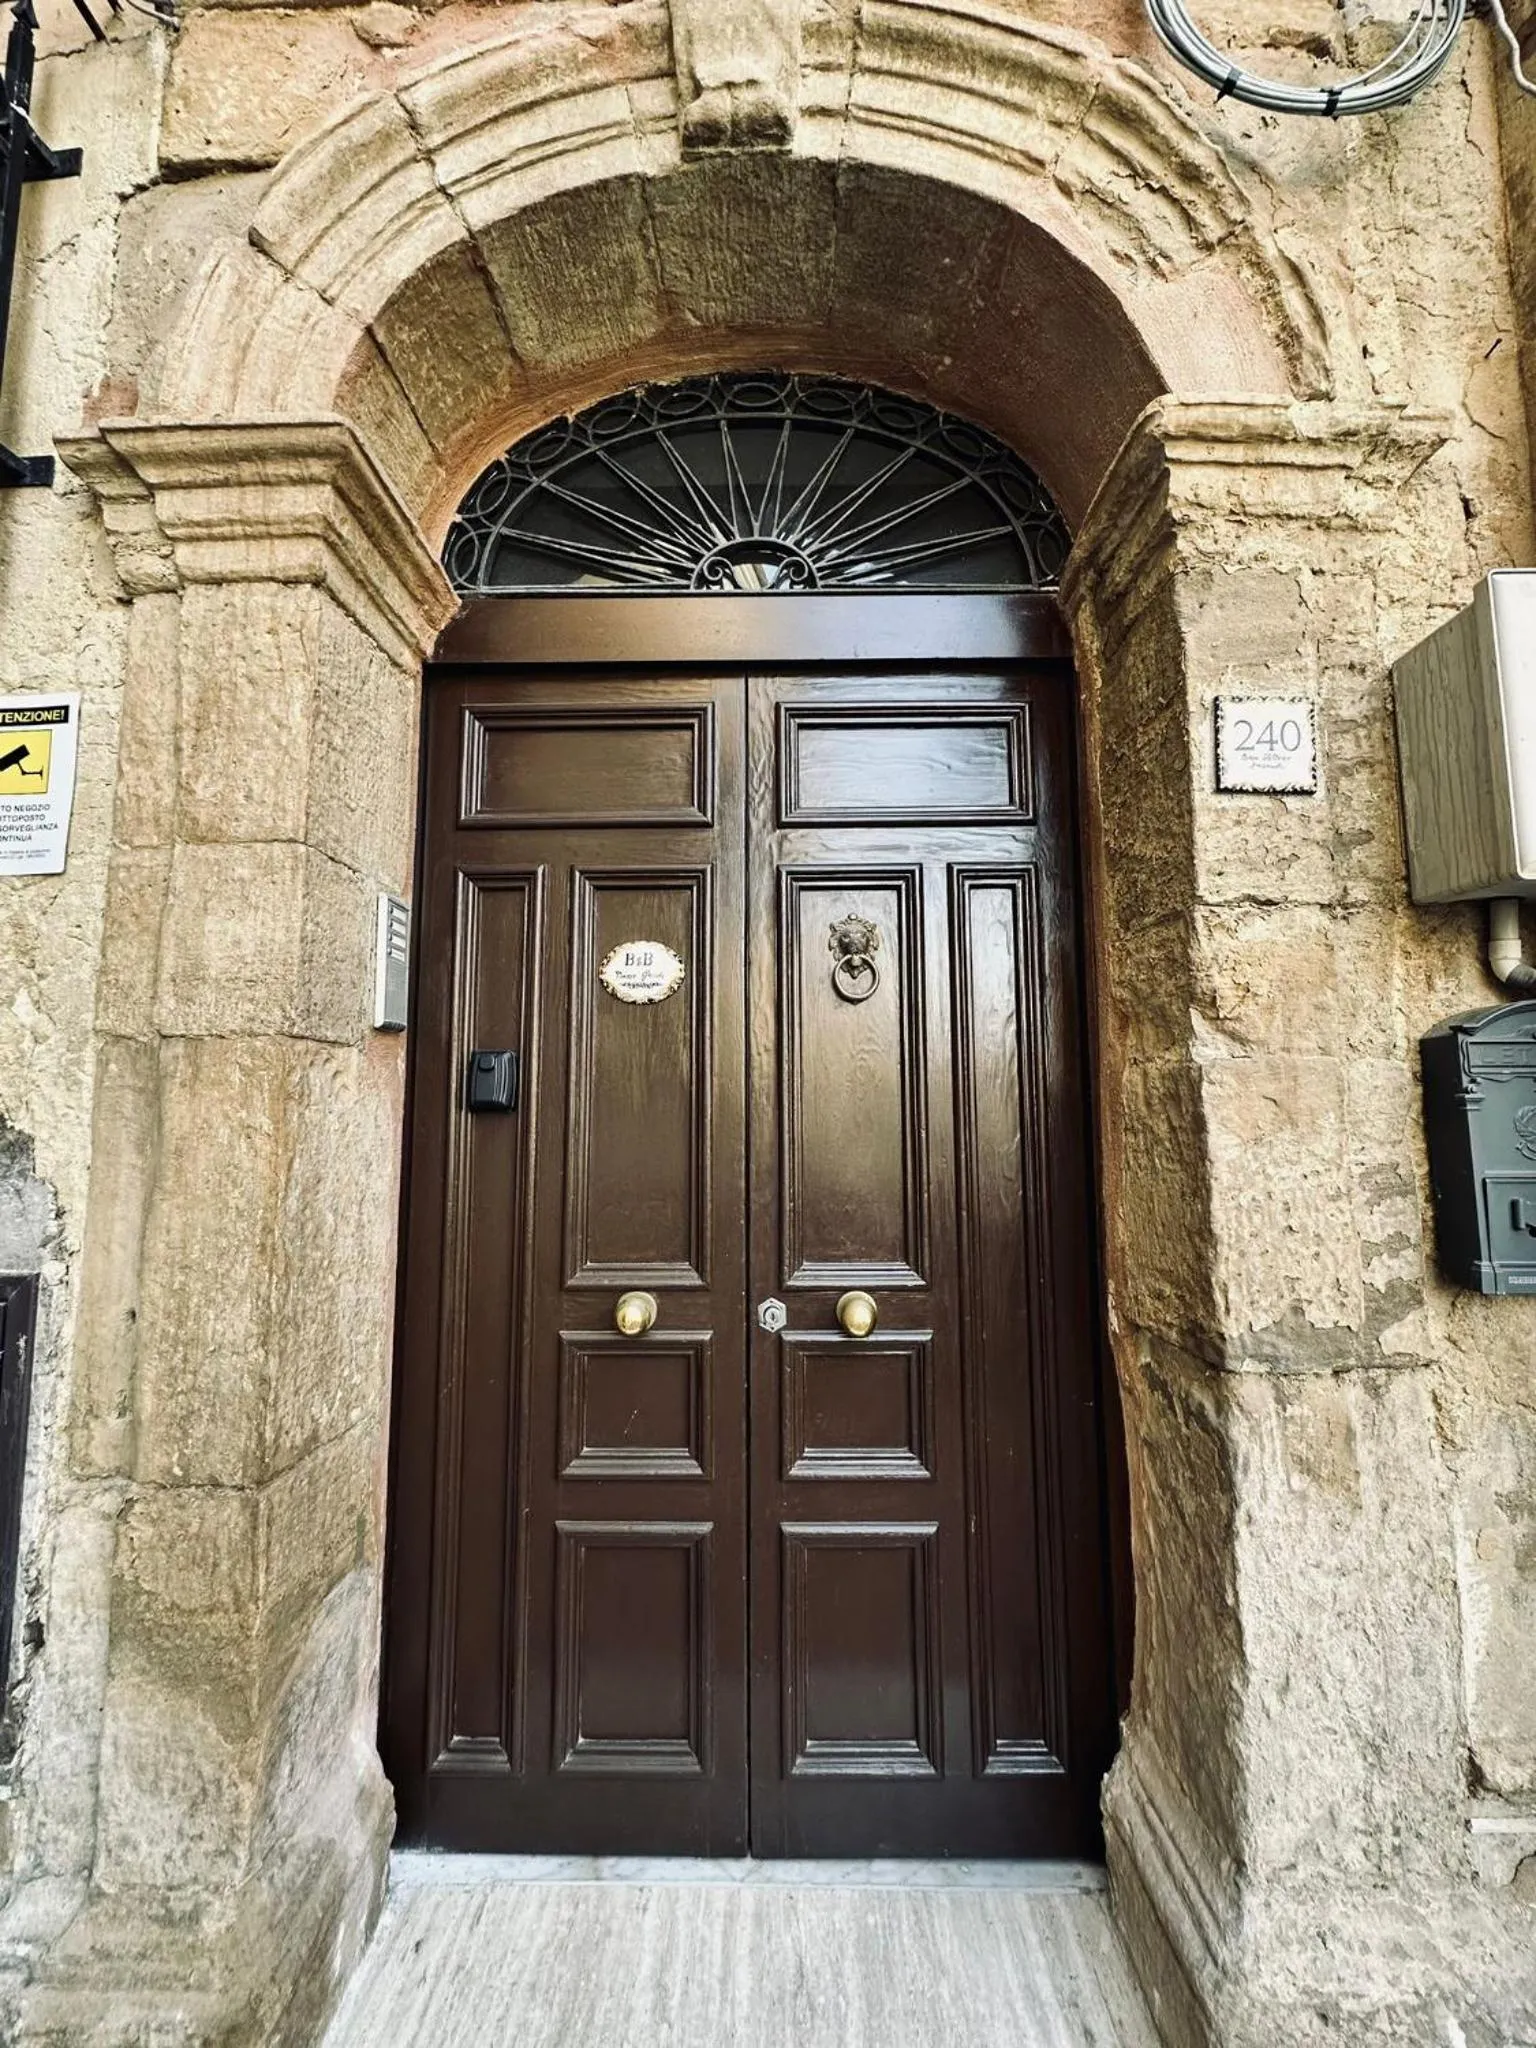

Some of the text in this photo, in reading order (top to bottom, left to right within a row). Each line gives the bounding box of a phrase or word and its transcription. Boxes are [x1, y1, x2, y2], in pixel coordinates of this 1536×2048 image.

[1233, 720, 1301, 751] 240
[14, 803, 51, 812] NEGOZIO
[0, 813, 46, 822] TTOPOSTO
